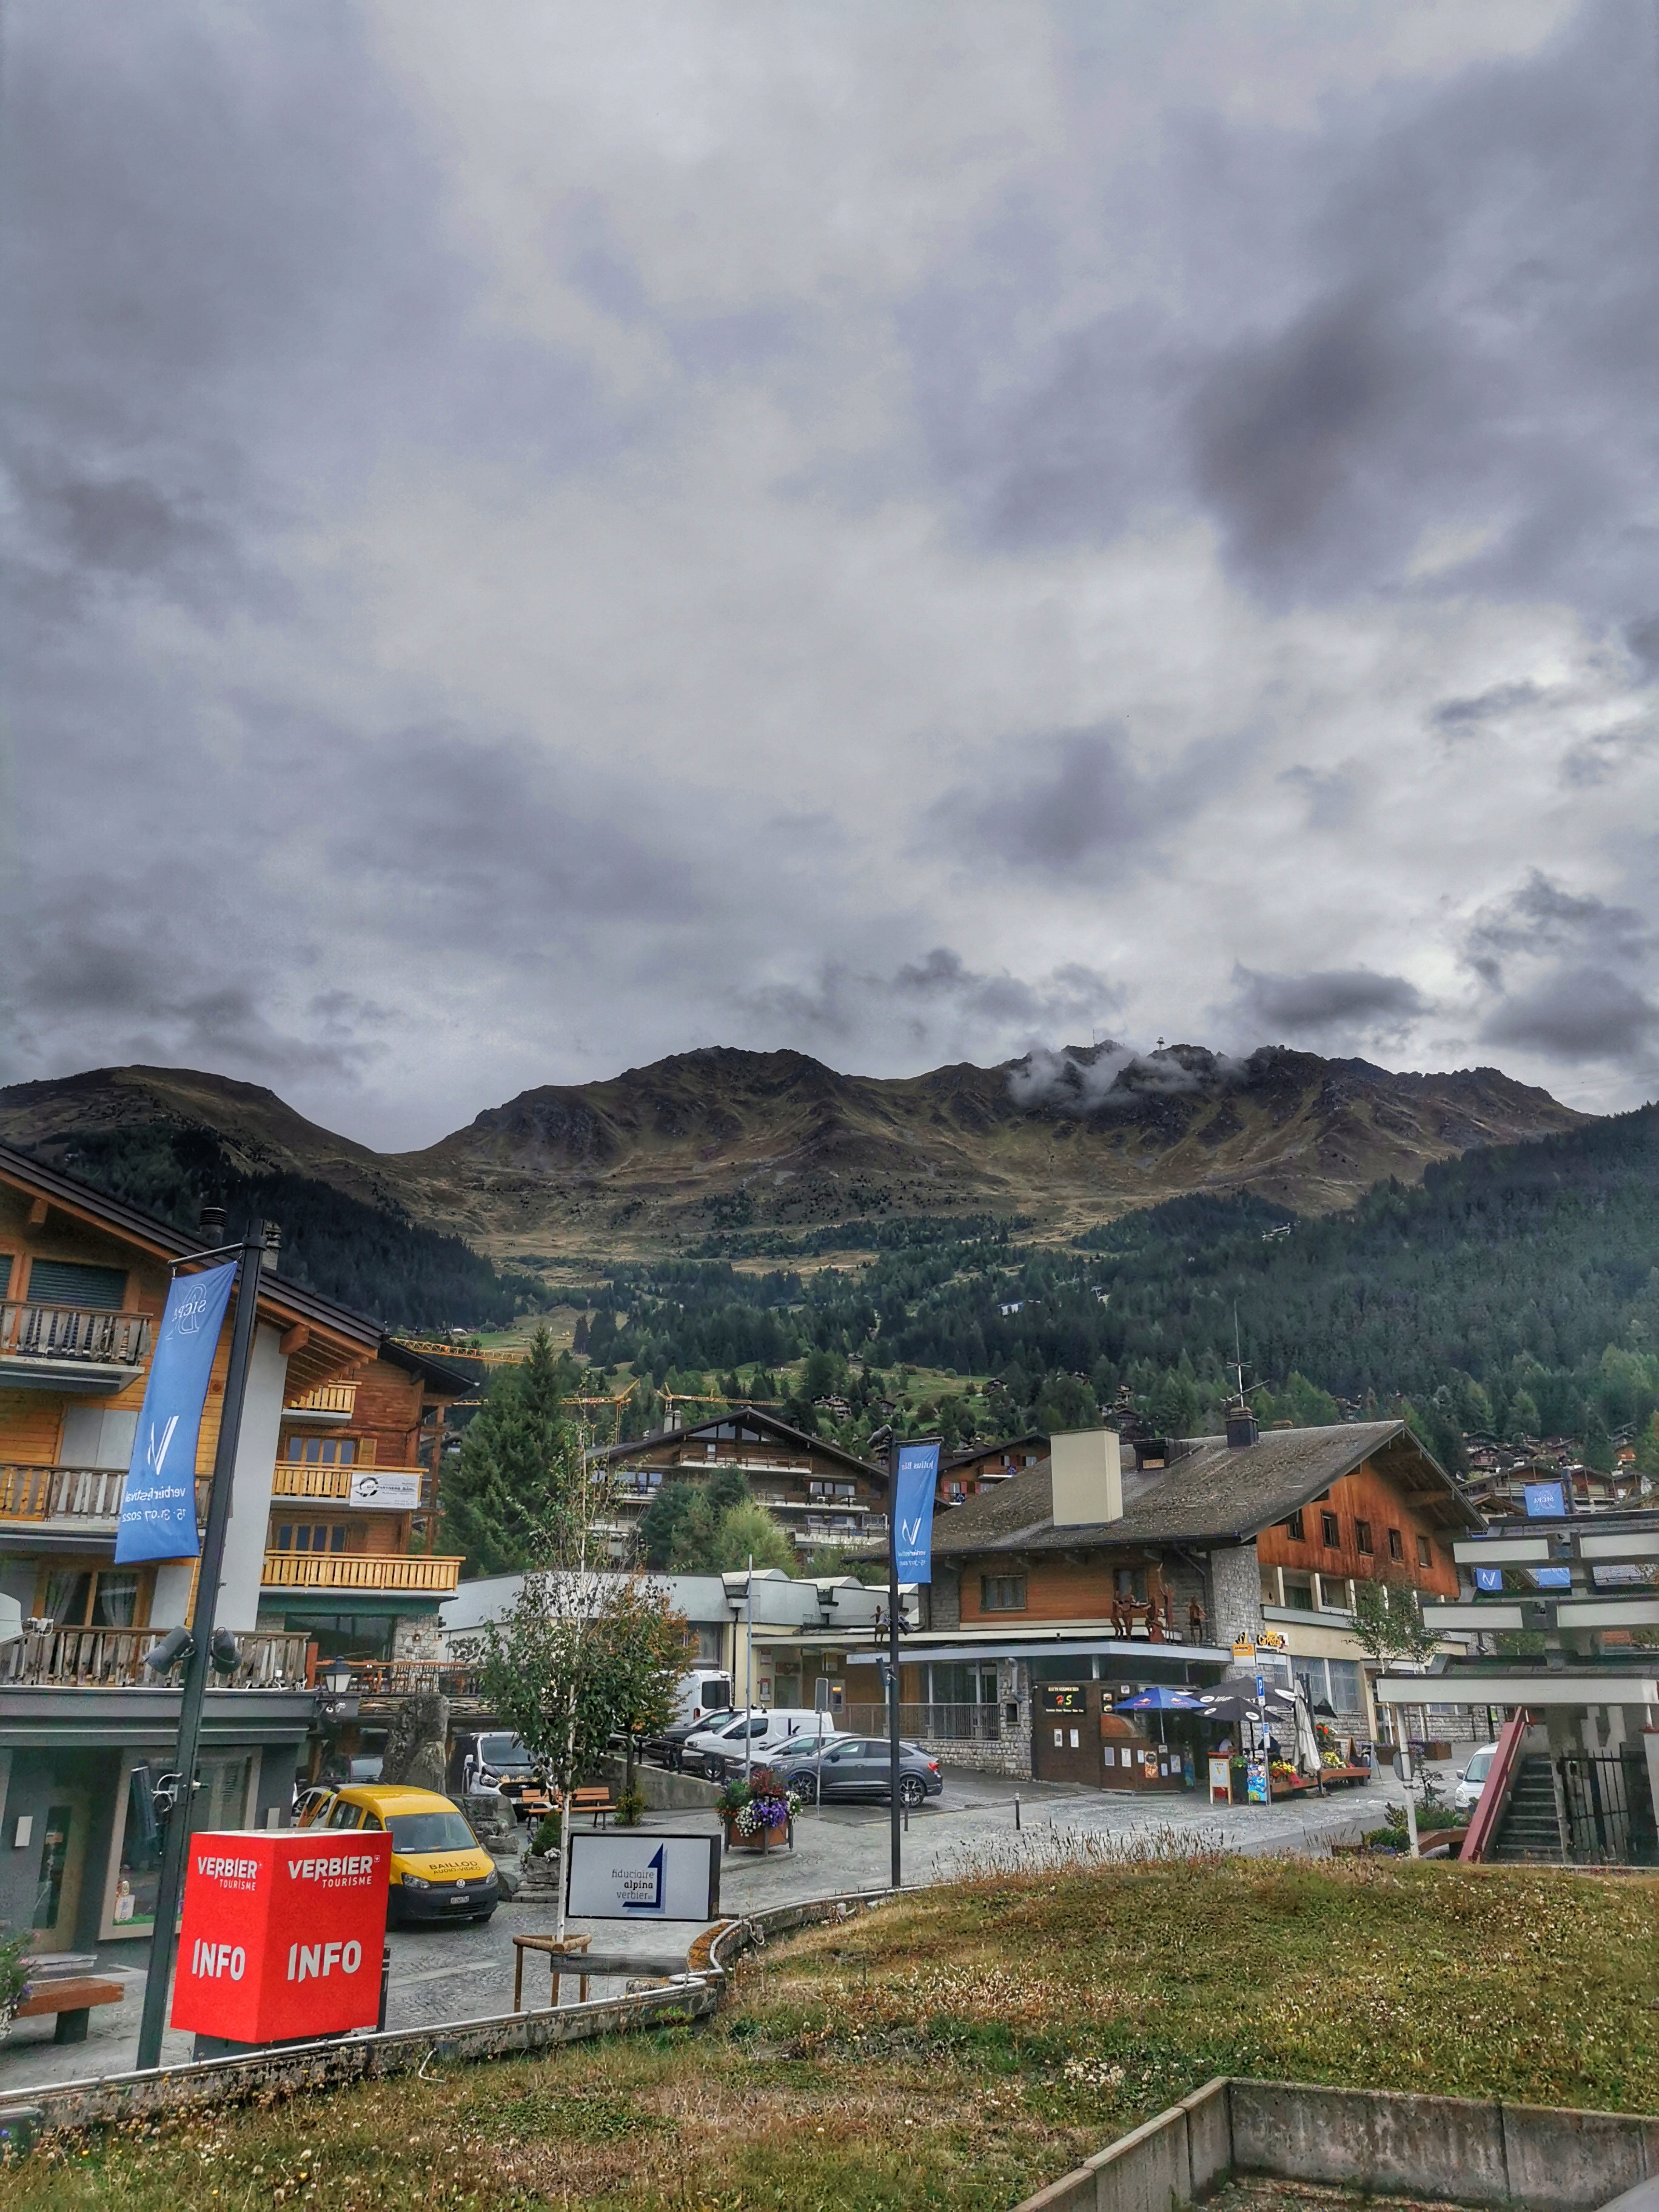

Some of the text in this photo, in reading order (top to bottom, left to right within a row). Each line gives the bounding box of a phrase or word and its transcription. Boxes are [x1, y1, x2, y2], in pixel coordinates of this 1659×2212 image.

[198, 1856, 258, 1880] VERBIER
[288, 1855, 373, 1882] VERBIER
[429, 1861, 478, 1870] BAILLOD
[612, 1869, 654, 1879] fiduciaire
[220, 1879, 256, 1891] TOURISME
[322, 1876, 372, 1888] TOURISME
[624, 1880, 654, 1891] alpina
[616, 1891, 648, 1899] verbier
[192, 1938, 246, 1980] INFO
[287, 1940, 362, 1983] INFO
